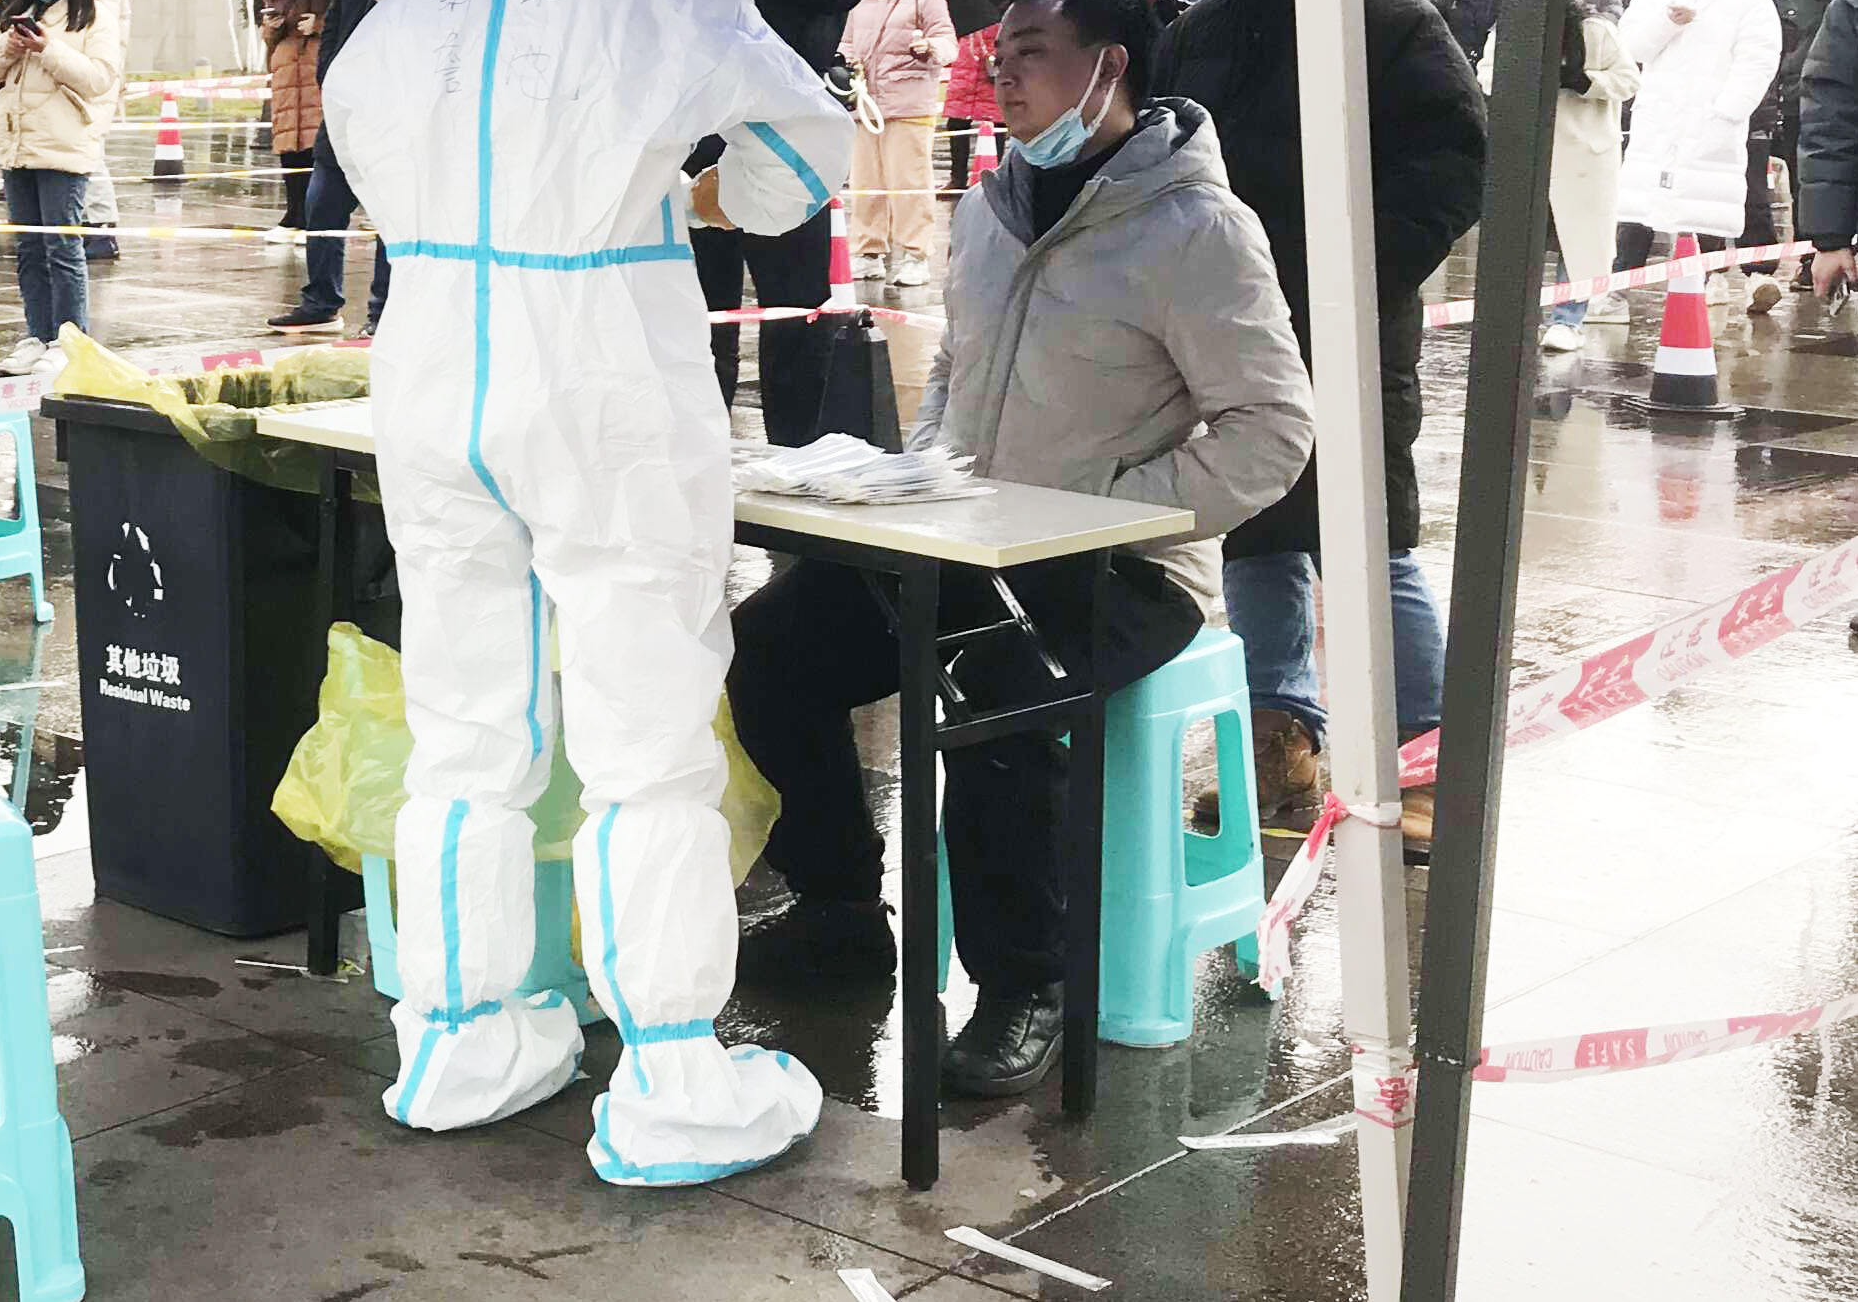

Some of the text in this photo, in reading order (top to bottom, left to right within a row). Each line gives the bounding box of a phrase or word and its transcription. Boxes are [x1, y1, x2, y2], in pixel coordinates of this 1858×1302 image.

[105, 643, 182, 686] 其他垃圾
[99, 677, 191, 712] Residual Waste
[1588, 1038, 1636, 1065] SAFE
